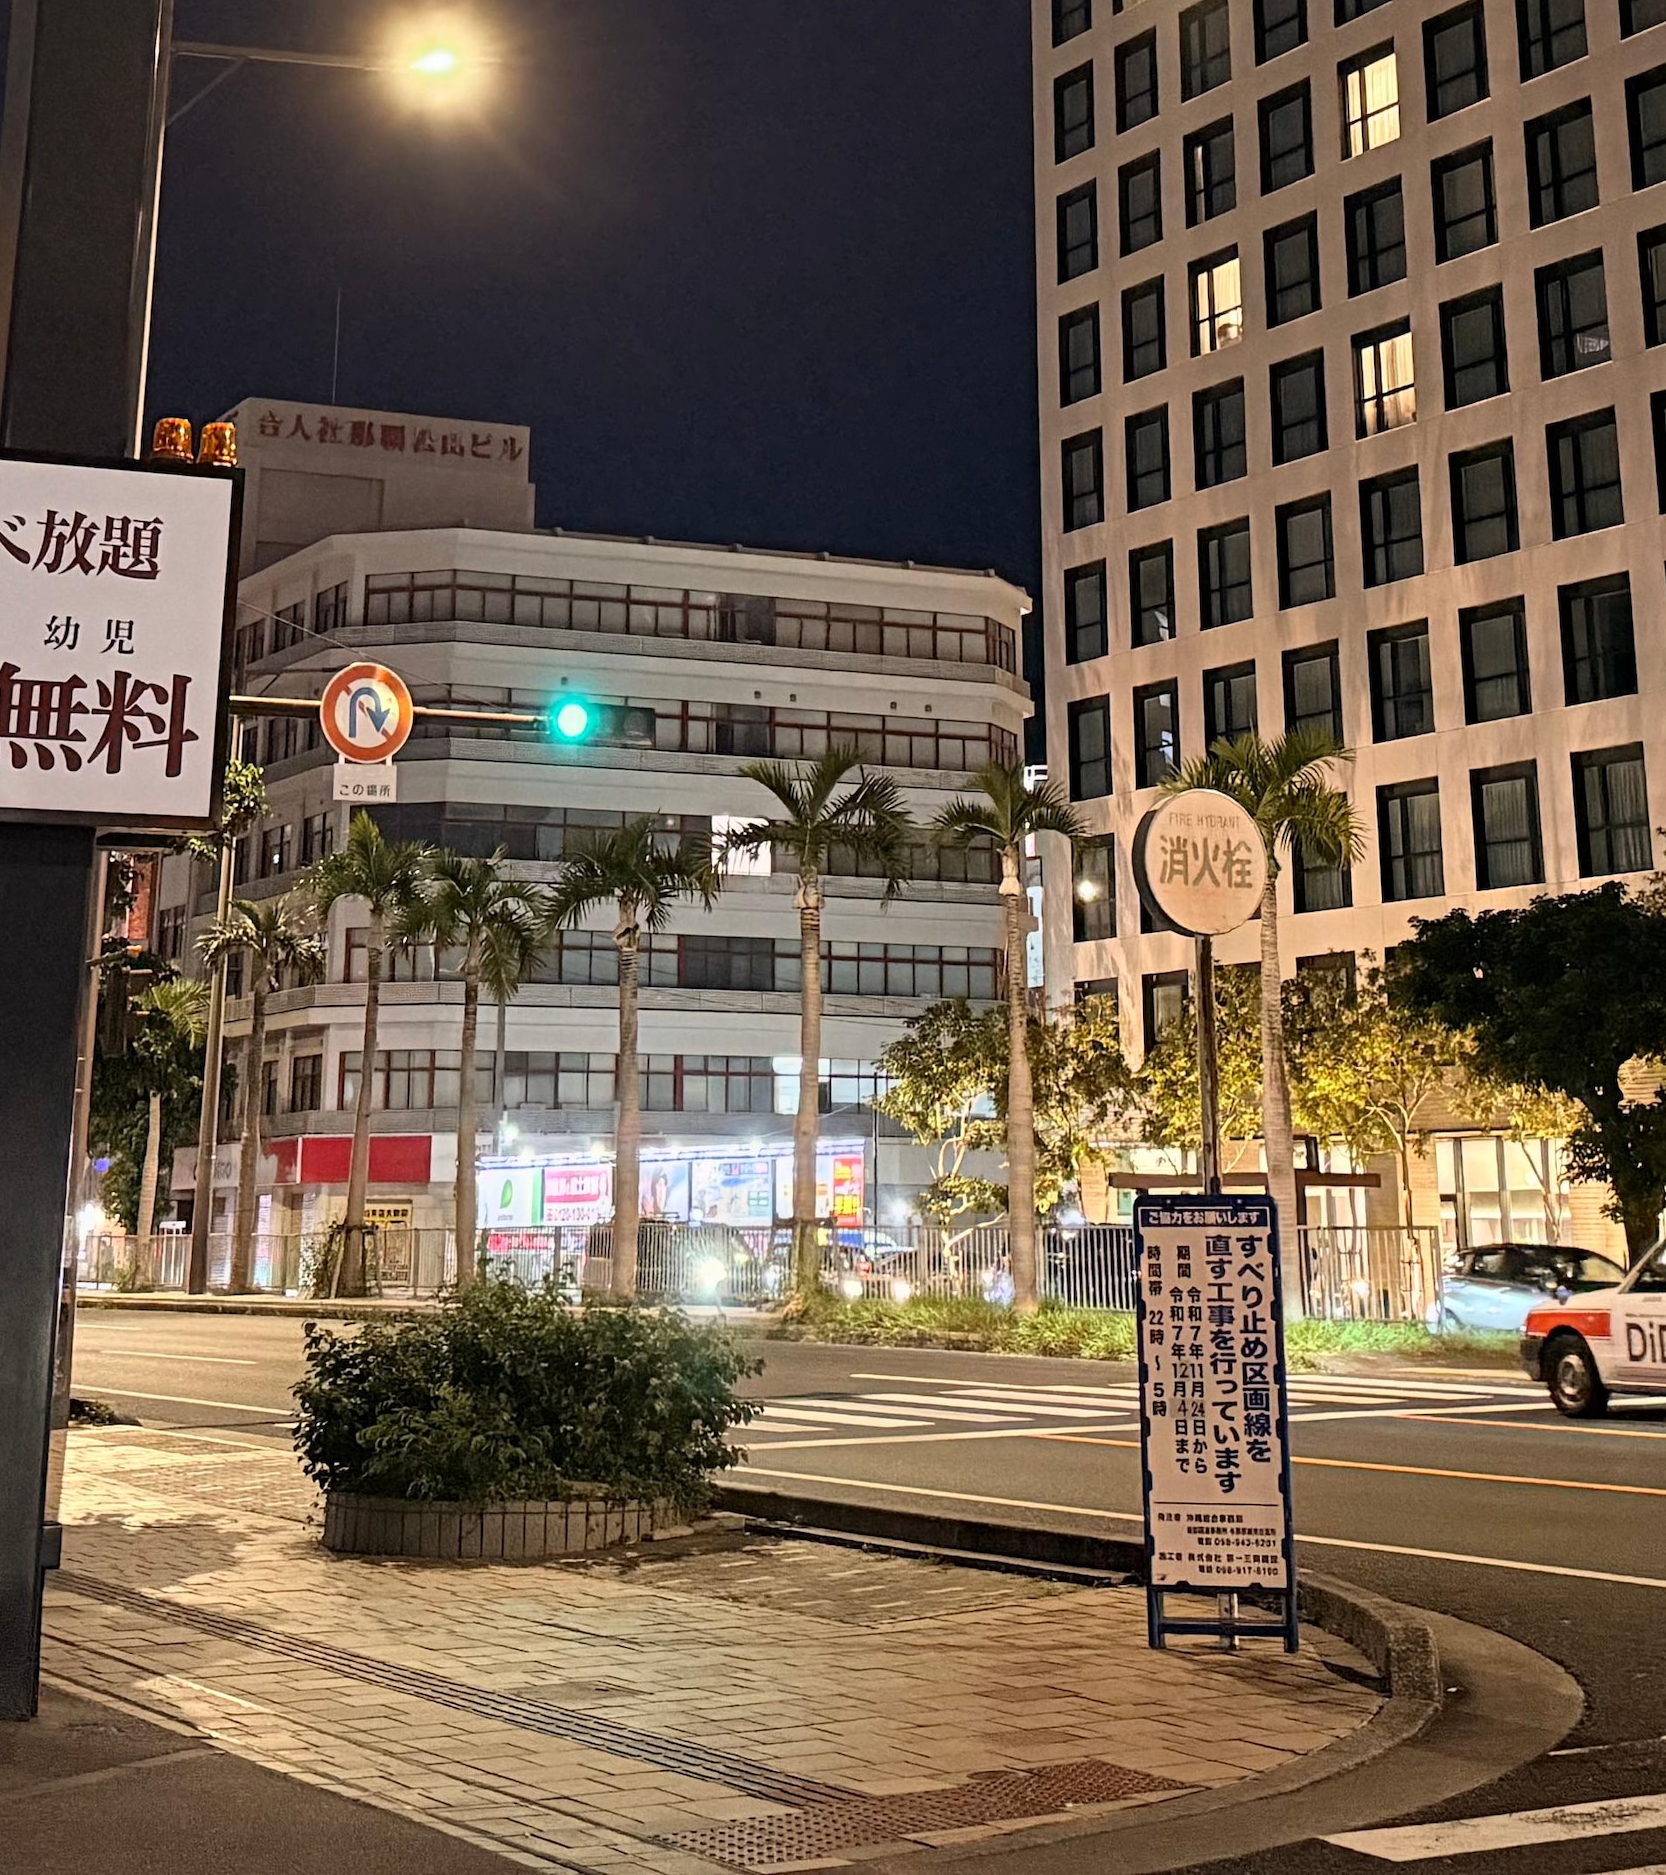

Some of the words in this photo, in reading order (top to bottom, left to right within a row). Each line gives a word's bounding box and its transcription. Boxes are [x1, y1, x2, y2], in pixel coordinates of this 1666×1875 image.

[45, 615, 135, 655] 幼児
[1169, 812, 1193, 827] FIRE
[1159, 835, 1253, 888] 消火栓
[1148, 1211, 1260, 1225] ご協力をお願いします
[1147, 1245, 1163, 1296] 時間帯
[1176, 1245, 1191, 1278] 期間
[1205, 1235, 1242, 1494] 直す工事を行っています
[1236, 1235, 1272, 1463] すべり止め区画線を
